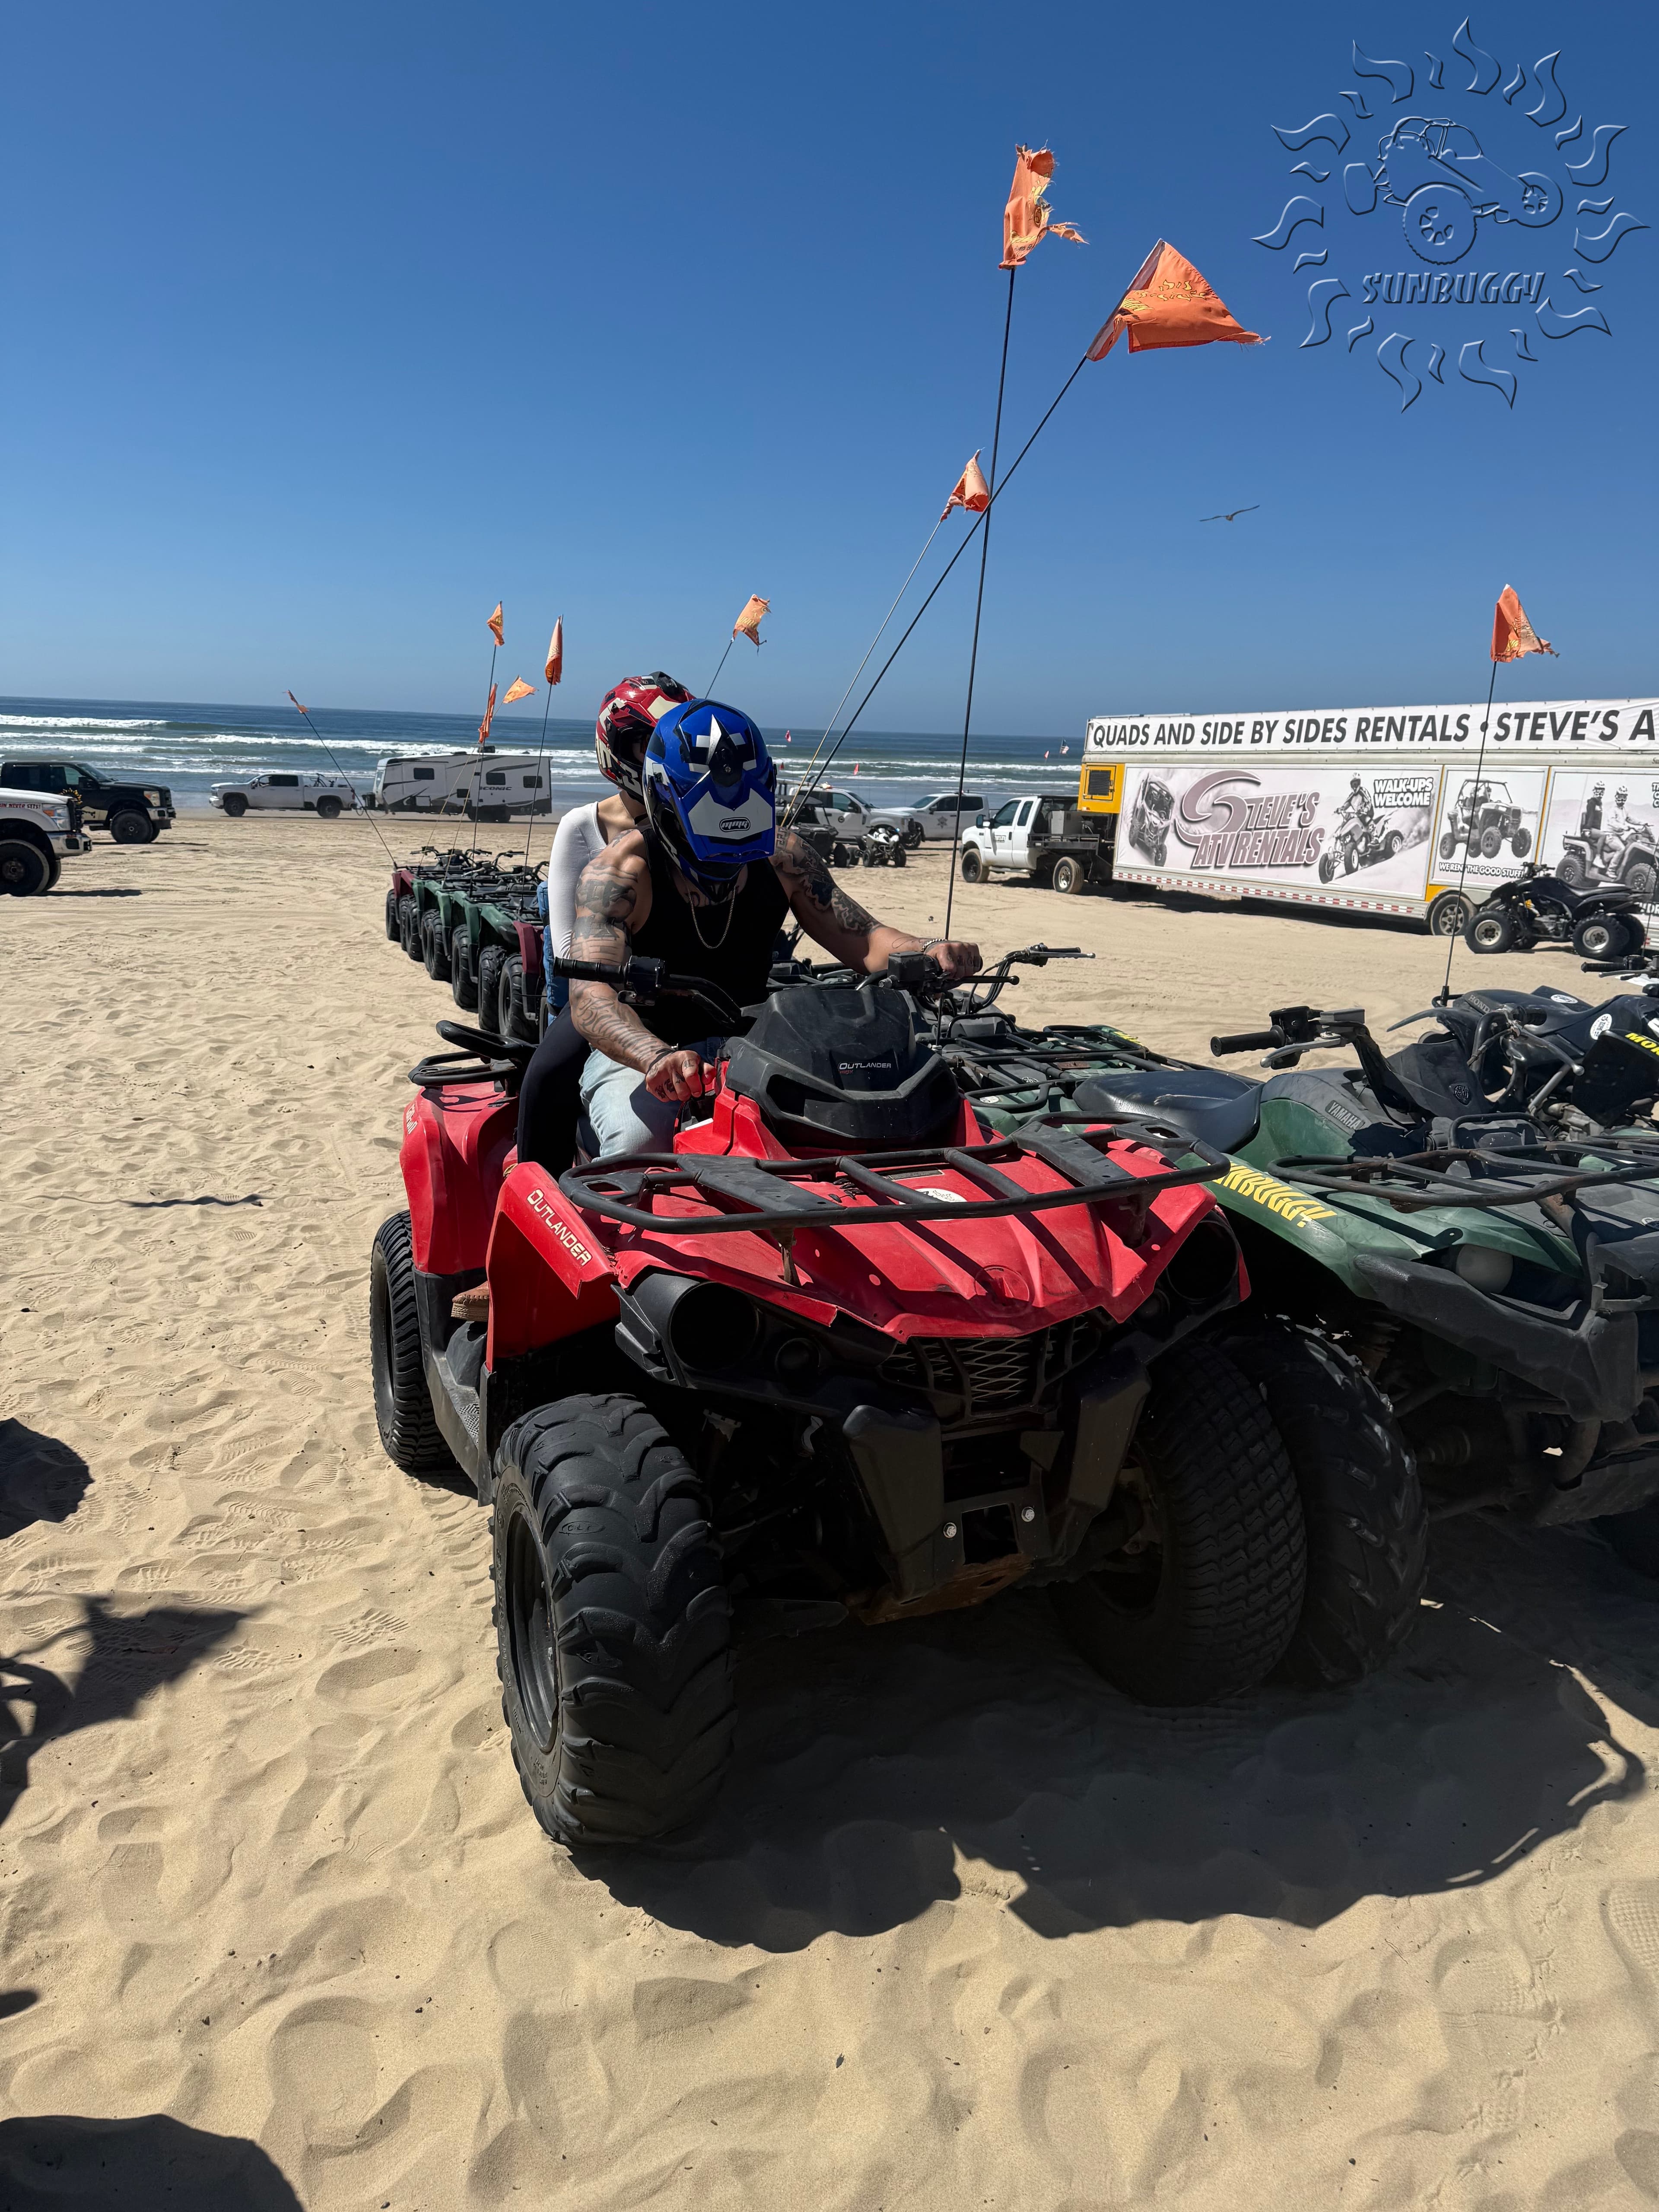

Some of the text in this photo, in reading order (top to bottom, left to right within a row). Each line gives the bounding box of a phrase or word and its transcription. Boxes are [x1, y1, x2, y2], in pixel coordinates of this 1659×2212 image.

[1093, 723, 1150, 747] QUADS
[1153, 723, 1195, 745] AND
[1200, 721, 1245, 745] SIDE
[1250, 719, 1279, 744] BY
[1282, 717, 1348, 744] SIDES
[1354, 713, 1470, 742] RENTALS
[1493, 709, 1620, 742] STEVE'S
[1373, 777, 1433, 793] WALK-UPS
[1373, 792, 1431, 808] WELCOME
[1192, 828, 1325, 866] ATV RENTALS
[1439, 862, 1450, 871] WE
[1450, 863, 1466, 873] REN
[1466, 864, 1479, 874] THE
[1479, 866, 1502, 876] GOOD
[1468, 995, 1491, 1014] HOND
[1328, 1102, 1362, 1130] YAMAHA
[1211, 1161, 1338, 1228] NBUGGY
[527, 1189, 592, 1266] OUTLANDER
